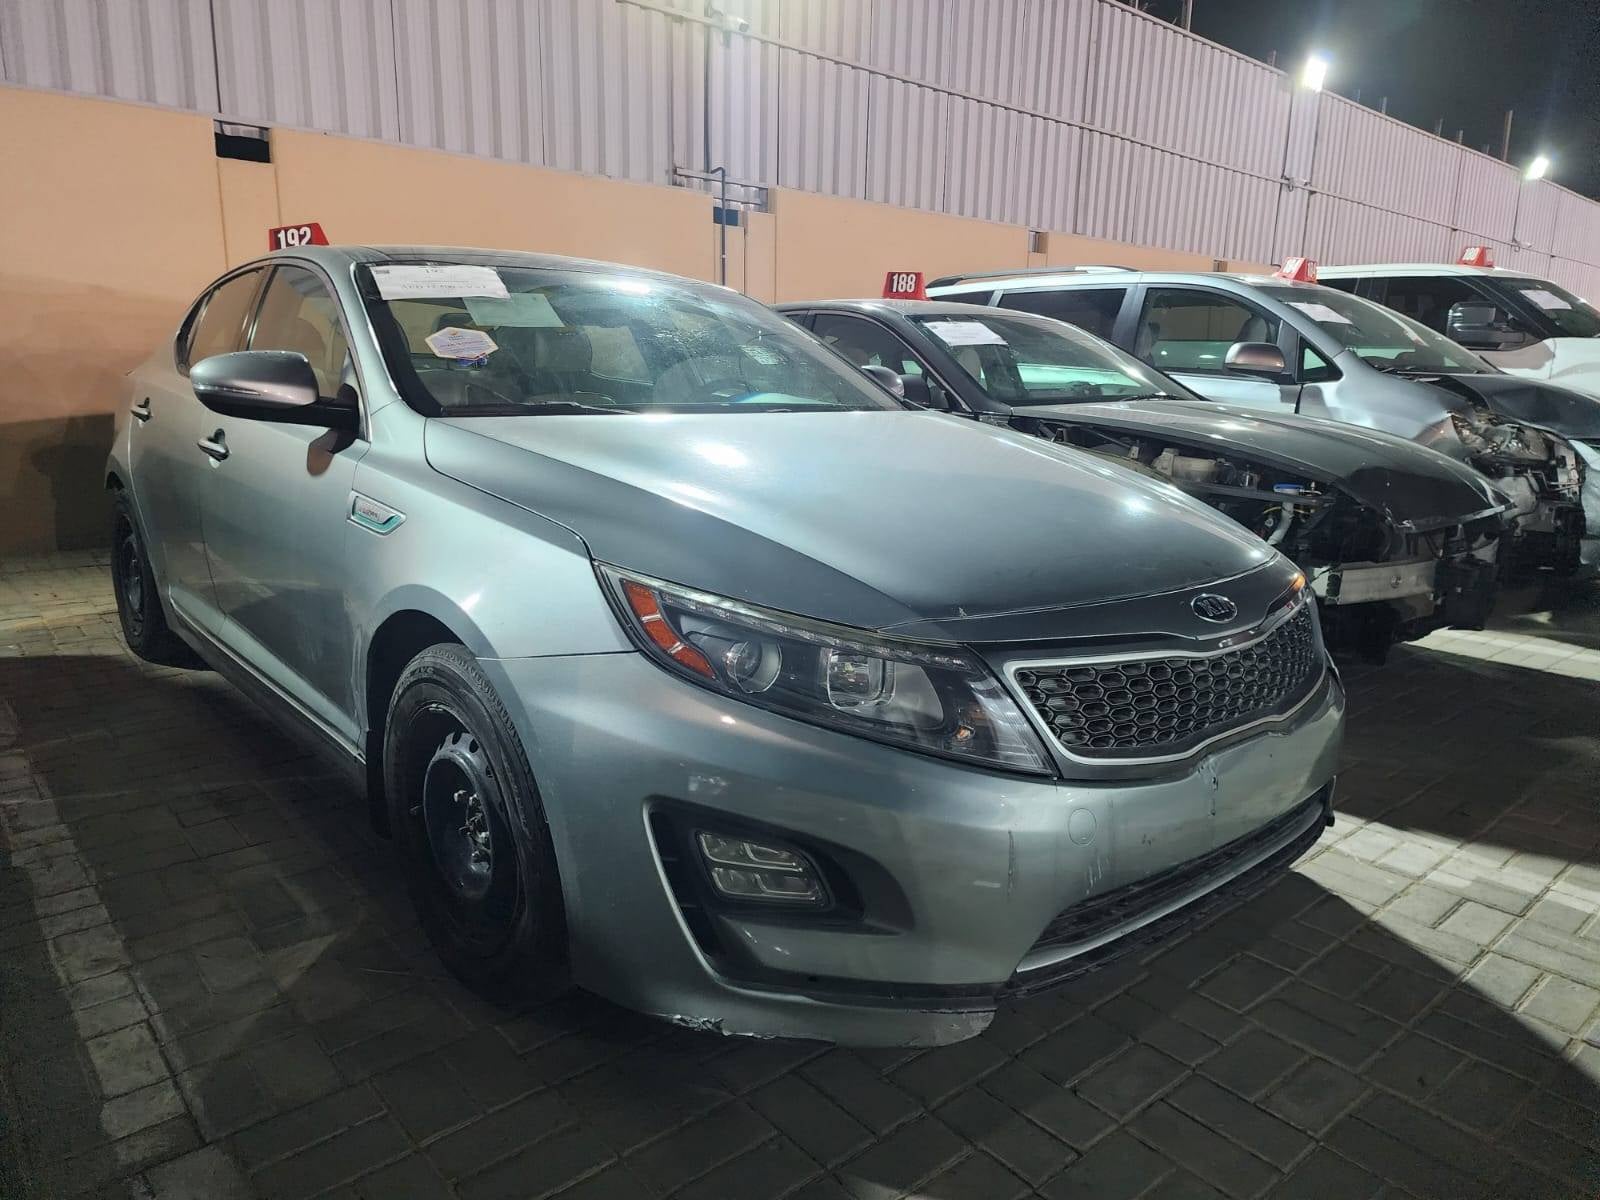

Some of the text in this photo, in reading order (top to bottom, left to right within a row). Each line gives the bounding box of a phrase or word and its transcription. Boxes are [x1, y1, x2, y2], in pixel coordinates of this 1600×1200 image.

[277, 226, 312, 250] 192
[892, 273, 916, 293] 188
[1195, 597, 1235, 618] KIA
